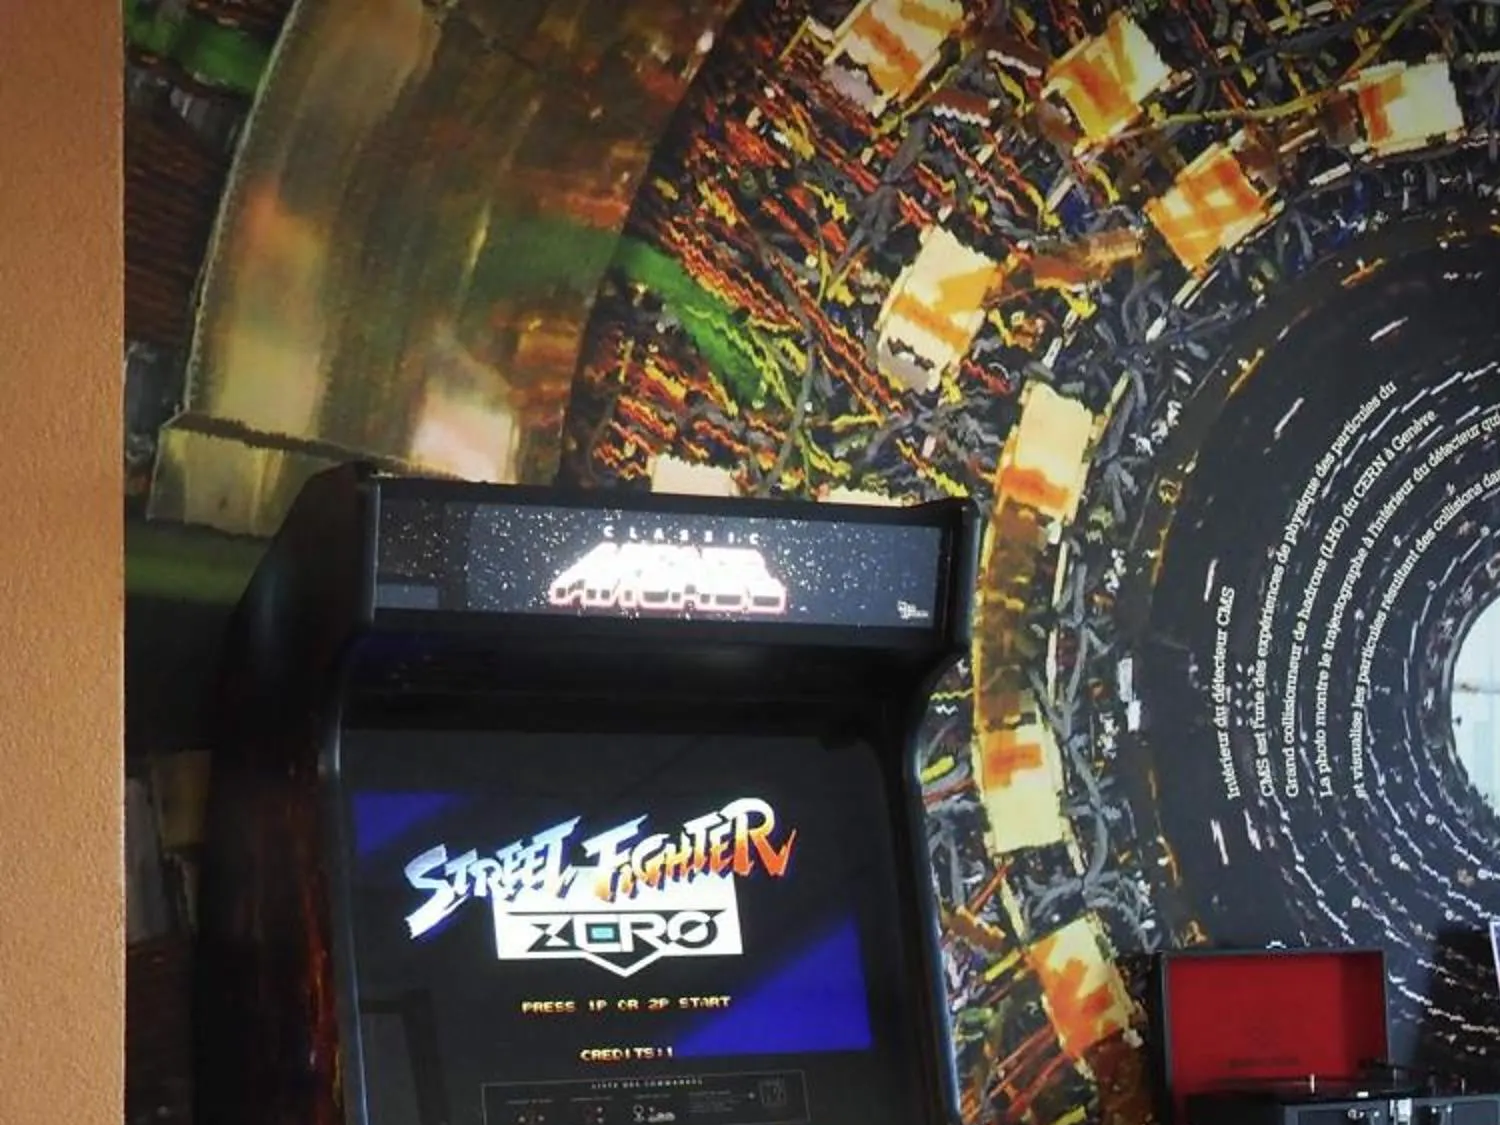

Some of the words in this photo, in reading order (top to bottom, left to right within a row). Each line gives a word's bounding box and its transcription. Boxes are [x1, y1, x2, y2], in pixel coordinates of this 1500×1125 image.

[1379, 380, 1398, 400] du
[1331, 396, 1383, 457] particules
[1428, 424, 1481, 467] détecteur
[1315, 451, 1336, 479] des
[1353, 453, 1388, 498] CERN
[1412, 462, 1431, 483] du
[1284, 477, 1321, 546] physique
[1341, 497, 1359, 518] du
[1433, 483, 1484, 531] collisions
[603, 525, 760, 545] CLASSIC
[1276, 543, 1291, 563] de
[1319, 515, 1350, 559] (LHC)
[1415, 527, 1436, 553] des
[1216, 585, 1235, 626] CMS
[1257, 564, 1285, 657] expériences
[1296, 557, 1329, 621] hadrons
[1321, 547, 1369, 650] trajectographe
[1292, 620, 1307, 641] de
[1357, 610, 1388, 684] particules
[1211, 628, 1228, 703] détecteur
[1254, 659, 1267, 688] des
[1317, 652, 1333, 669] le
[1282, 642, 1302, 744] collisionneur
[1314, 669, 1330, 727] montre
[1351, 685, 1366, 708] les
[1213, 705, 1228, 727] du
[1217, 730, 1241, 800] Intérieur
[1314, 729, 1332, 774] photo
[1349, 709, 1364, 781] visualise
[1256, 758, 1275, 797] CMS
[1282, 746, 1299, 797] Grand
[1319, 775, 1333, 798] La
[403, 815, 583, 940] STREET
[582, 797, 797, 903] FIGHTER
[513, 909, 725, 953] ZERO
[521, 1000, 576, 1013] PRESS
[589, 999, 607, 1012] 1P
[617, 999, 639, 1011] OR
[648, 998, 669, 1010] 2P
[678, 995, 731, 1009] START
